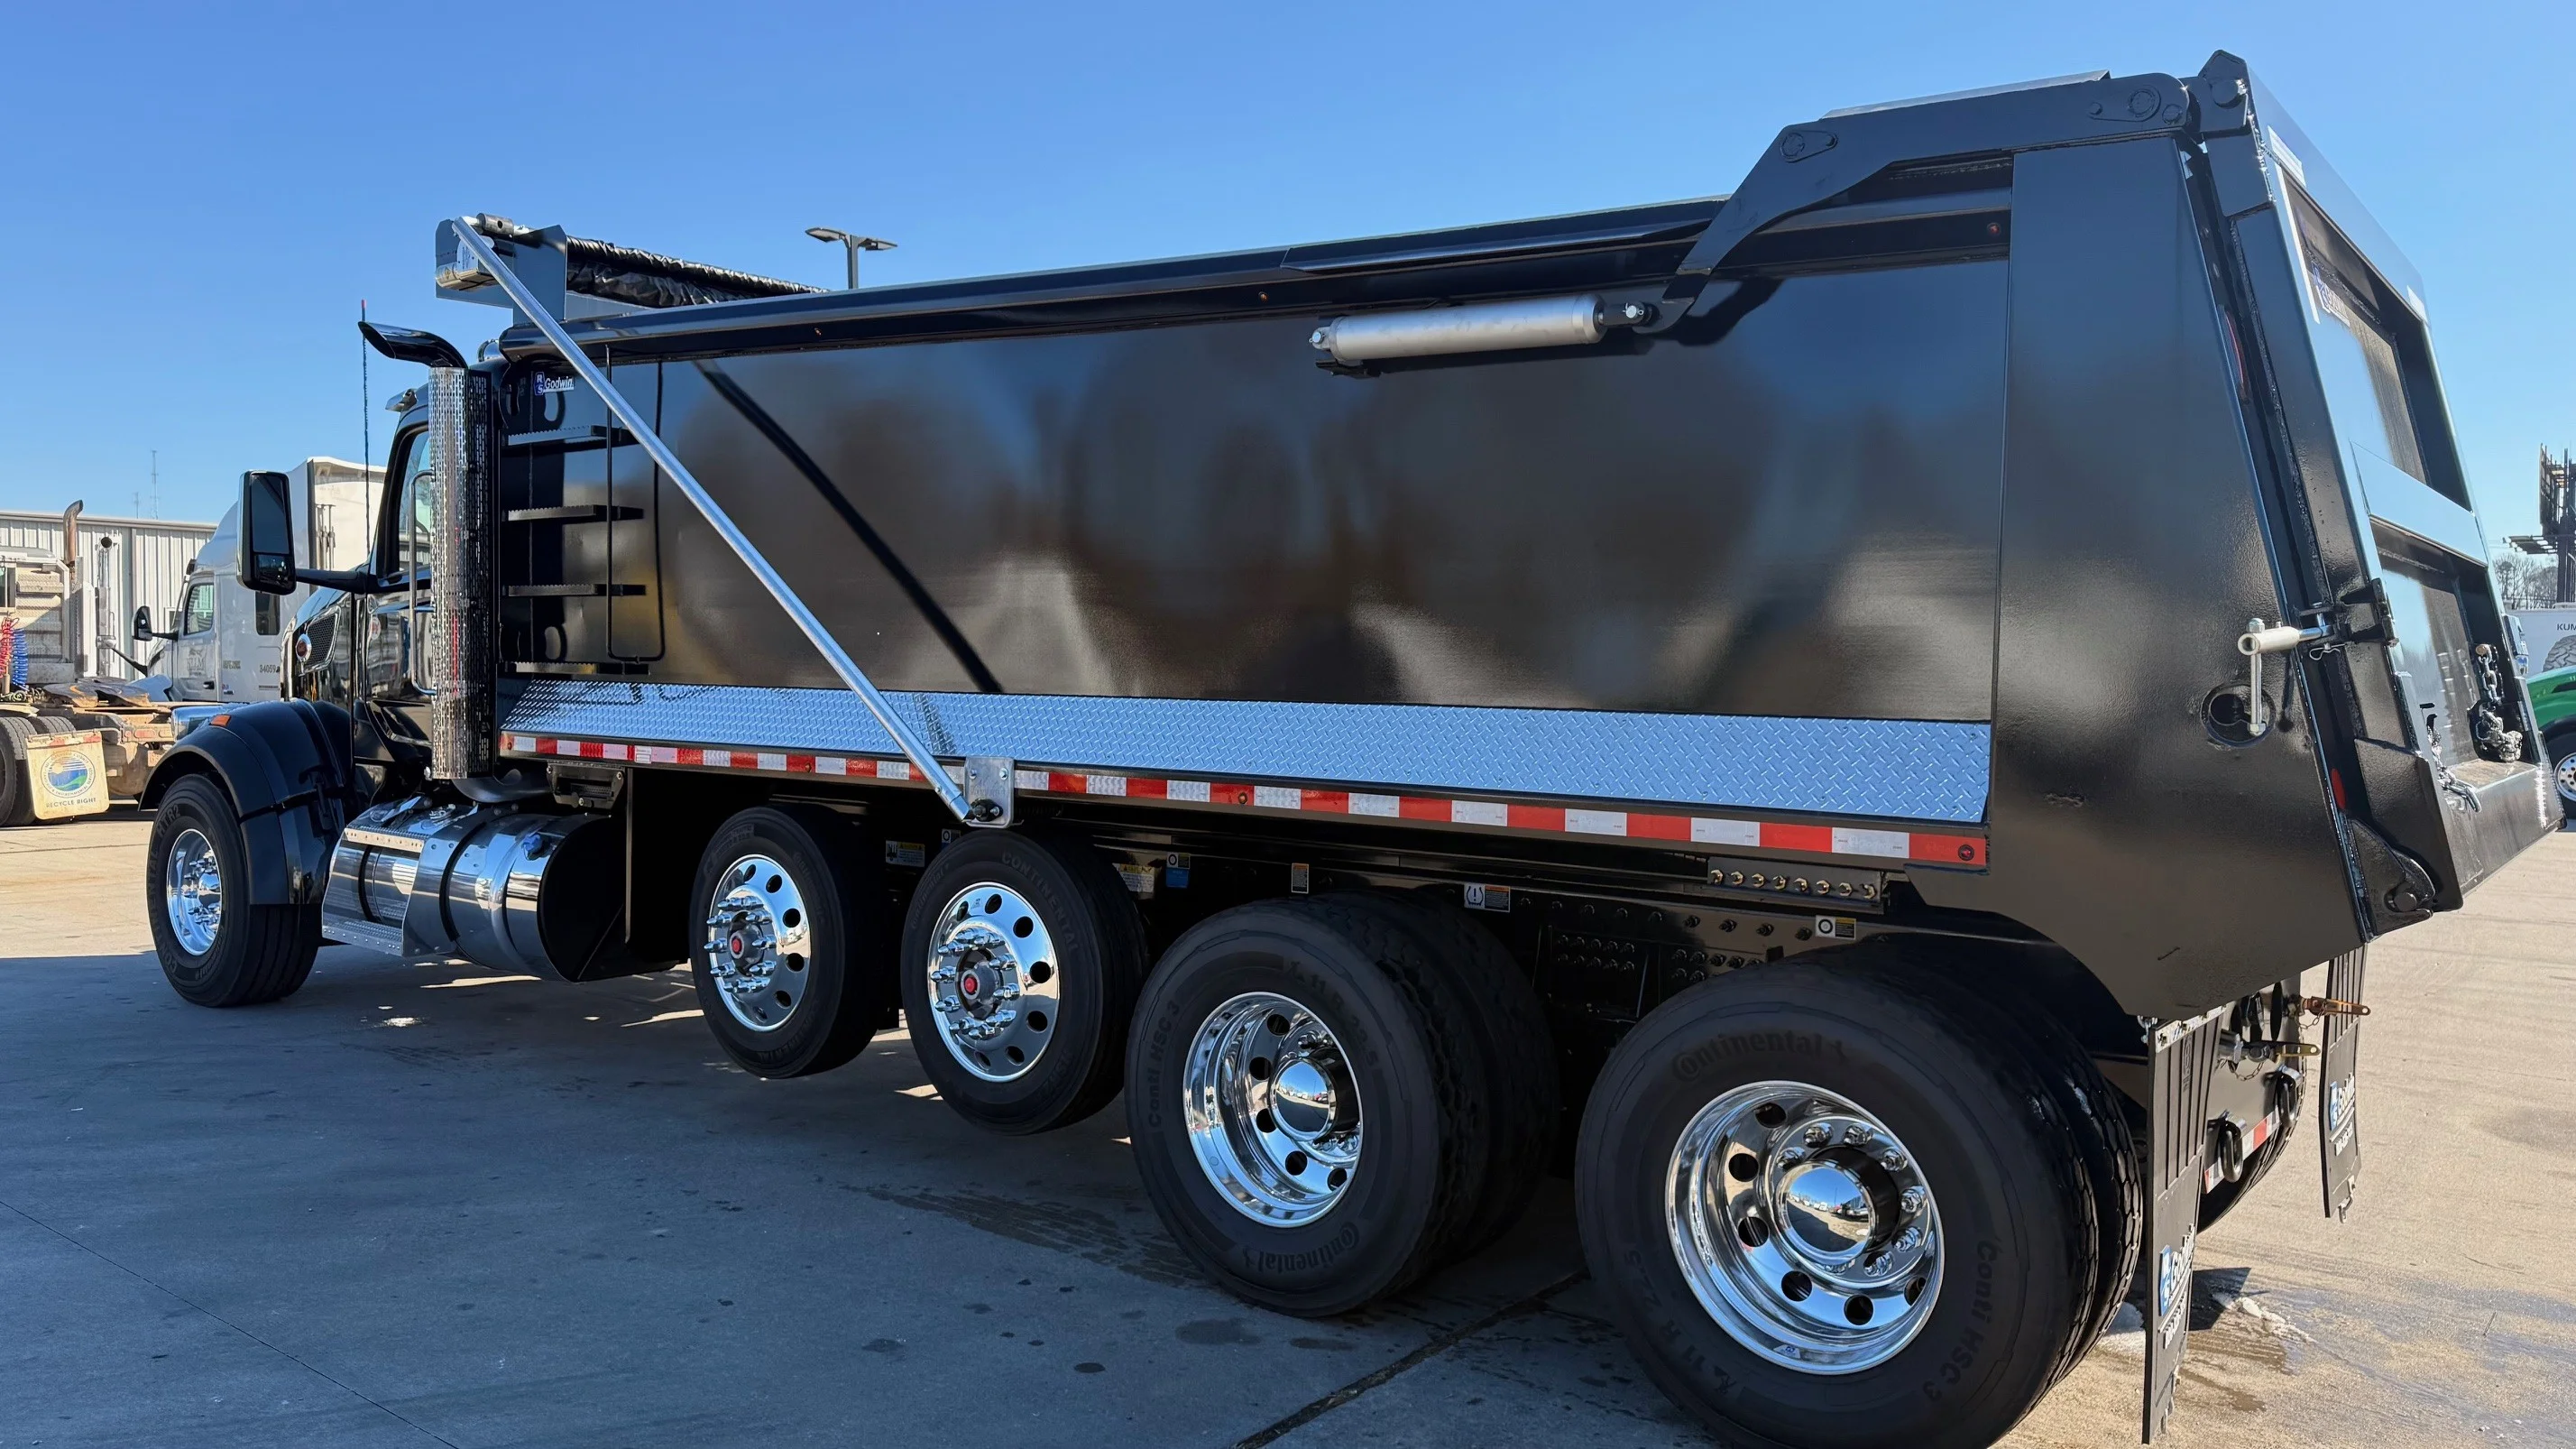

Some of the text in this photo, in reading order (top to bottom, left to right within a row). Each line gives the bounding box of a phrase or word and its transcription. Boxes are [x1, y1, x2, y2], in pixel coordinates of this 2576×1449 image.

[546, 376, 574, 389] Godwin
[46, 797, 97, 808] RECYCLE RIGHT
[1002, 850, 1078, 950] CONTINENTAL
[1147, 1002, 1181, 1128] Conti HSC 3
[1672, 1030, 1822, 1081] Continental
[1262, 1221, 1360, 1273] Continental
[1659, 1319, 1683, 1343] R
[1922, 1239, 1999, 1403] Conti HSC 3
